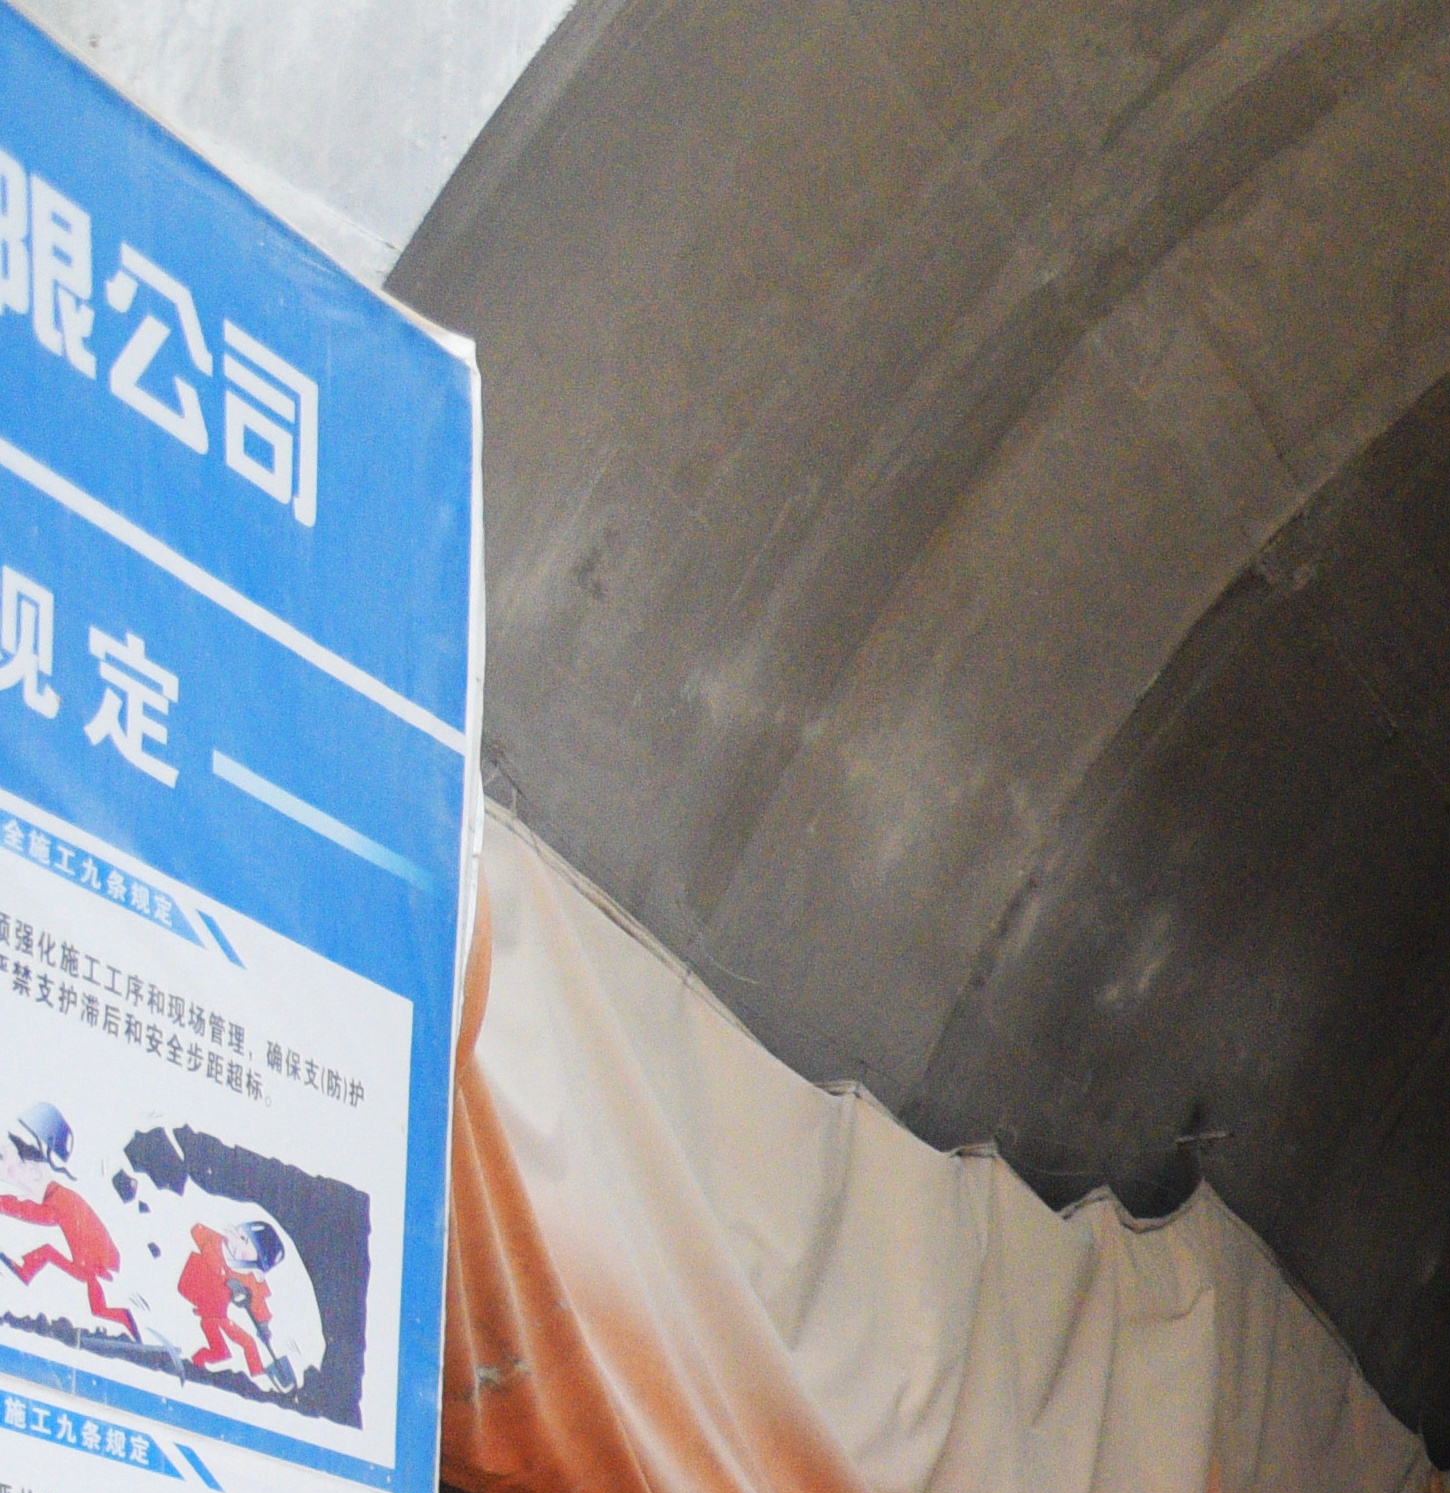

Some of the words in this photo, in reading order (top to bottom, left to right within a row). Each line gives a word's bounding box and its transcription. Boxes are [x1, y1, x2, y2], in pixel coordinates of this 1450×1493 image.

[2, 819, 173, 927] 全施工九条规定
[4, 1397, 150, 1466] 施工九条规定
